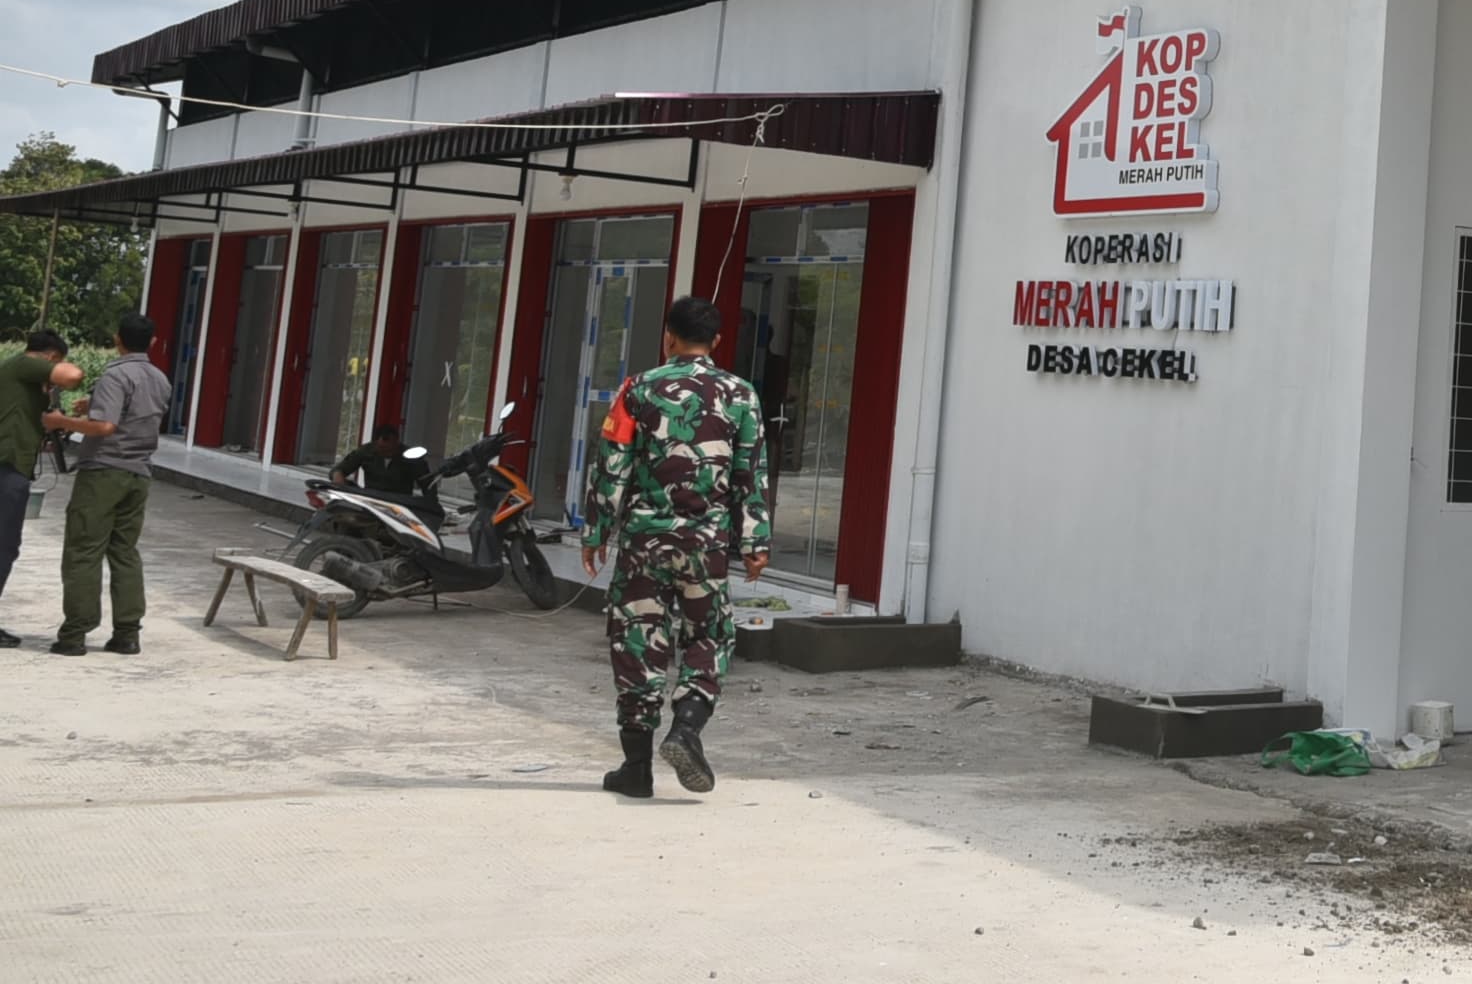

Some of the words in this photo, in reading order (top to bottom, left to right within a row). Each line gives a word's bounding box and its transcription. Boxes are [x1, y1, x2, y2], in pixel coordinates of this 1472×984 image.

[1136, 32, 1206, 78] KOP
[1133, 76, 1198, 120] DES
[1129, 121, 1194, 163] KEL
[1119, 167, 1163, 184] MERAH
[1166, 164, 1204, 181] PUTIH
[1064, 232, 1176, 265] KOPERASI
[1012, 280, 1121, 328] MERAH
[1128, 278, 1234, 332] PUTIH
[1026, 343, 1094, 375] DESA
[1102, 347, 1196, 381] CEKEL
